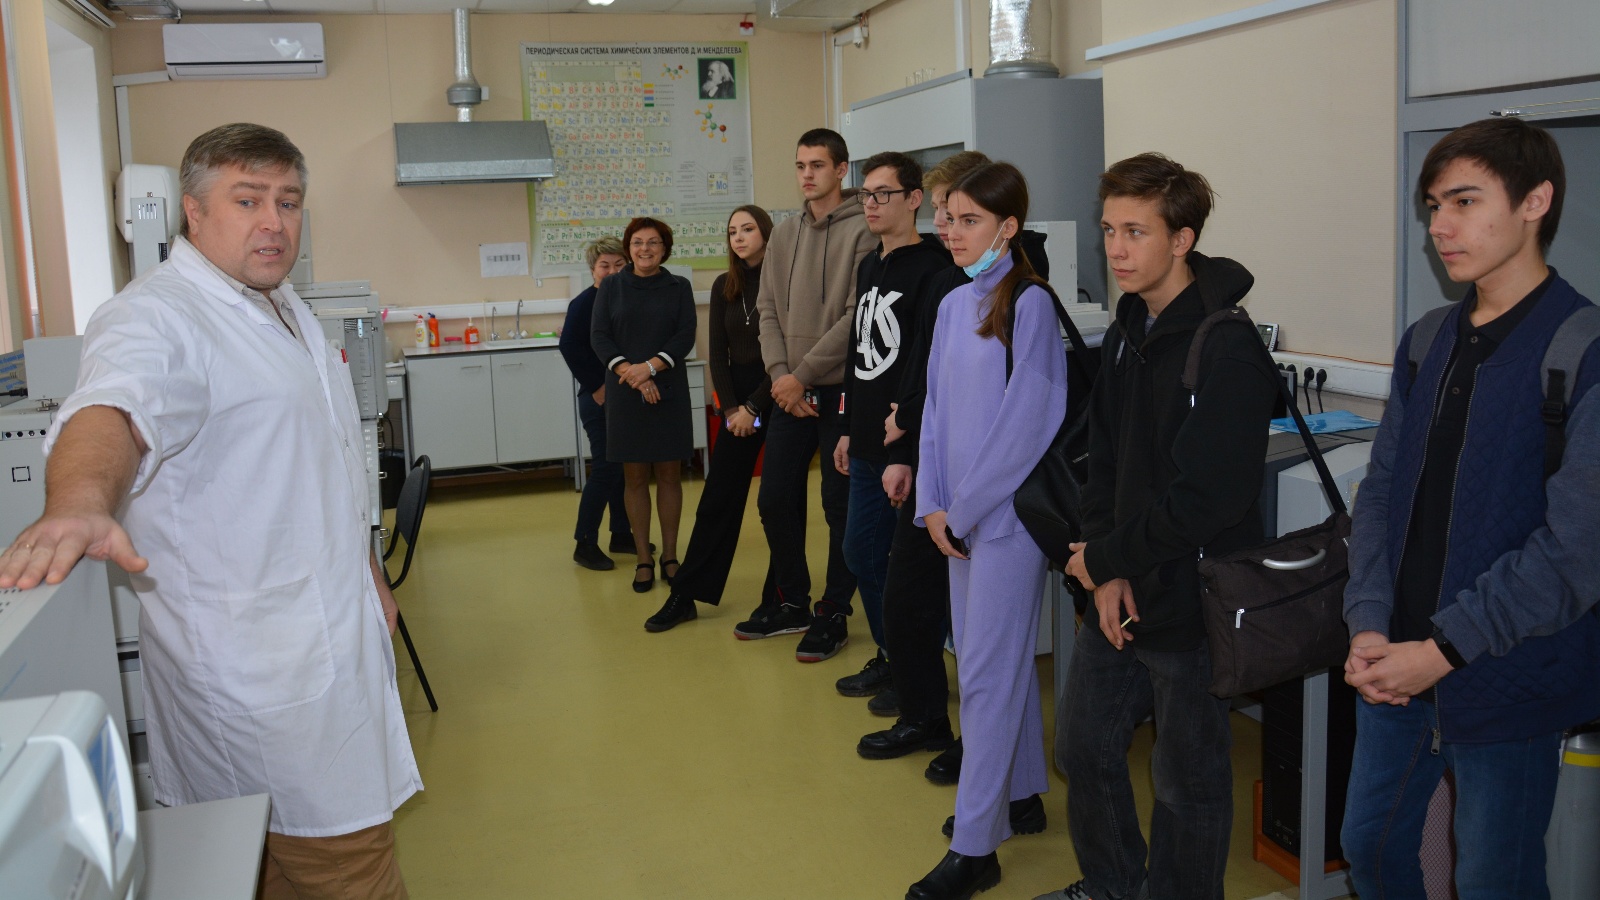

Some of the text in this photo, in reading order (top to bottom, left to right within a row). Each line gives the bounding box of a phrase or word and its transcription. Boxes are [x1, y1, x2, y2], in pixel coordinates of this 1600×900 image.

[526, 47, 578, 55] ПЕРИОДИЧЕСКАЯ
[653, 46, 689, 54] ЭЛЕМЕНТОВ
[716, 181, 728, 190] Mo
